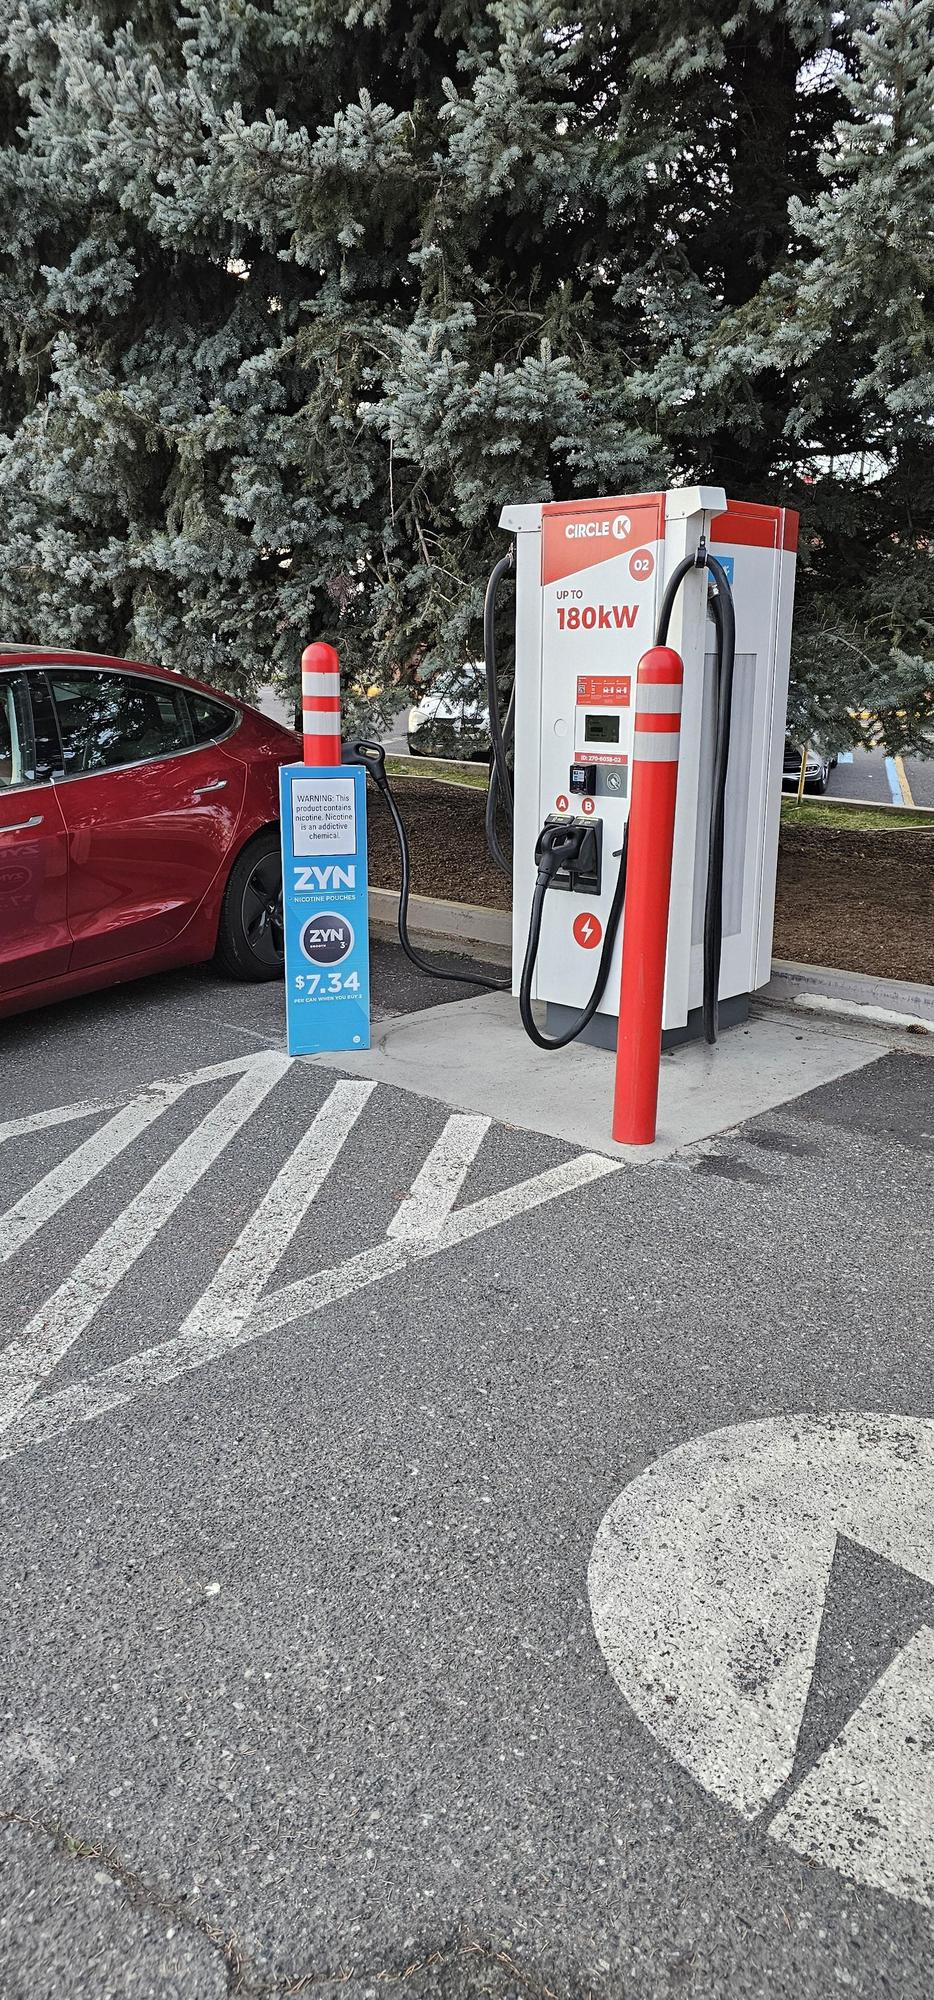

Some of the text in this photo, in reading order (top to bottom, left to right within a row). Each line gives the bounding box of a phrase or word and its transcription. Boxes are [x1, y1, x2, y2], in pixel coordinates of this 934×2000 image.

[565, 518, 630, 539] CIRCLE K
[634, 559, 649, 571] 02
[556, 589, 583, 600] UP TO
[557, 605, 639, 630] 180kW
[297, 794, 334, 802] WARNING:
[296, 805, 322, 813] product
[559, 799, 566, 809] A
[585, 801, 592, 811] B
[309, 832, 343, 840] chemical.
[293, 865, 356, 891] ZYN
[310, 928, 344, 943] ZYN
[295, 971, 360, 995] $7.34
